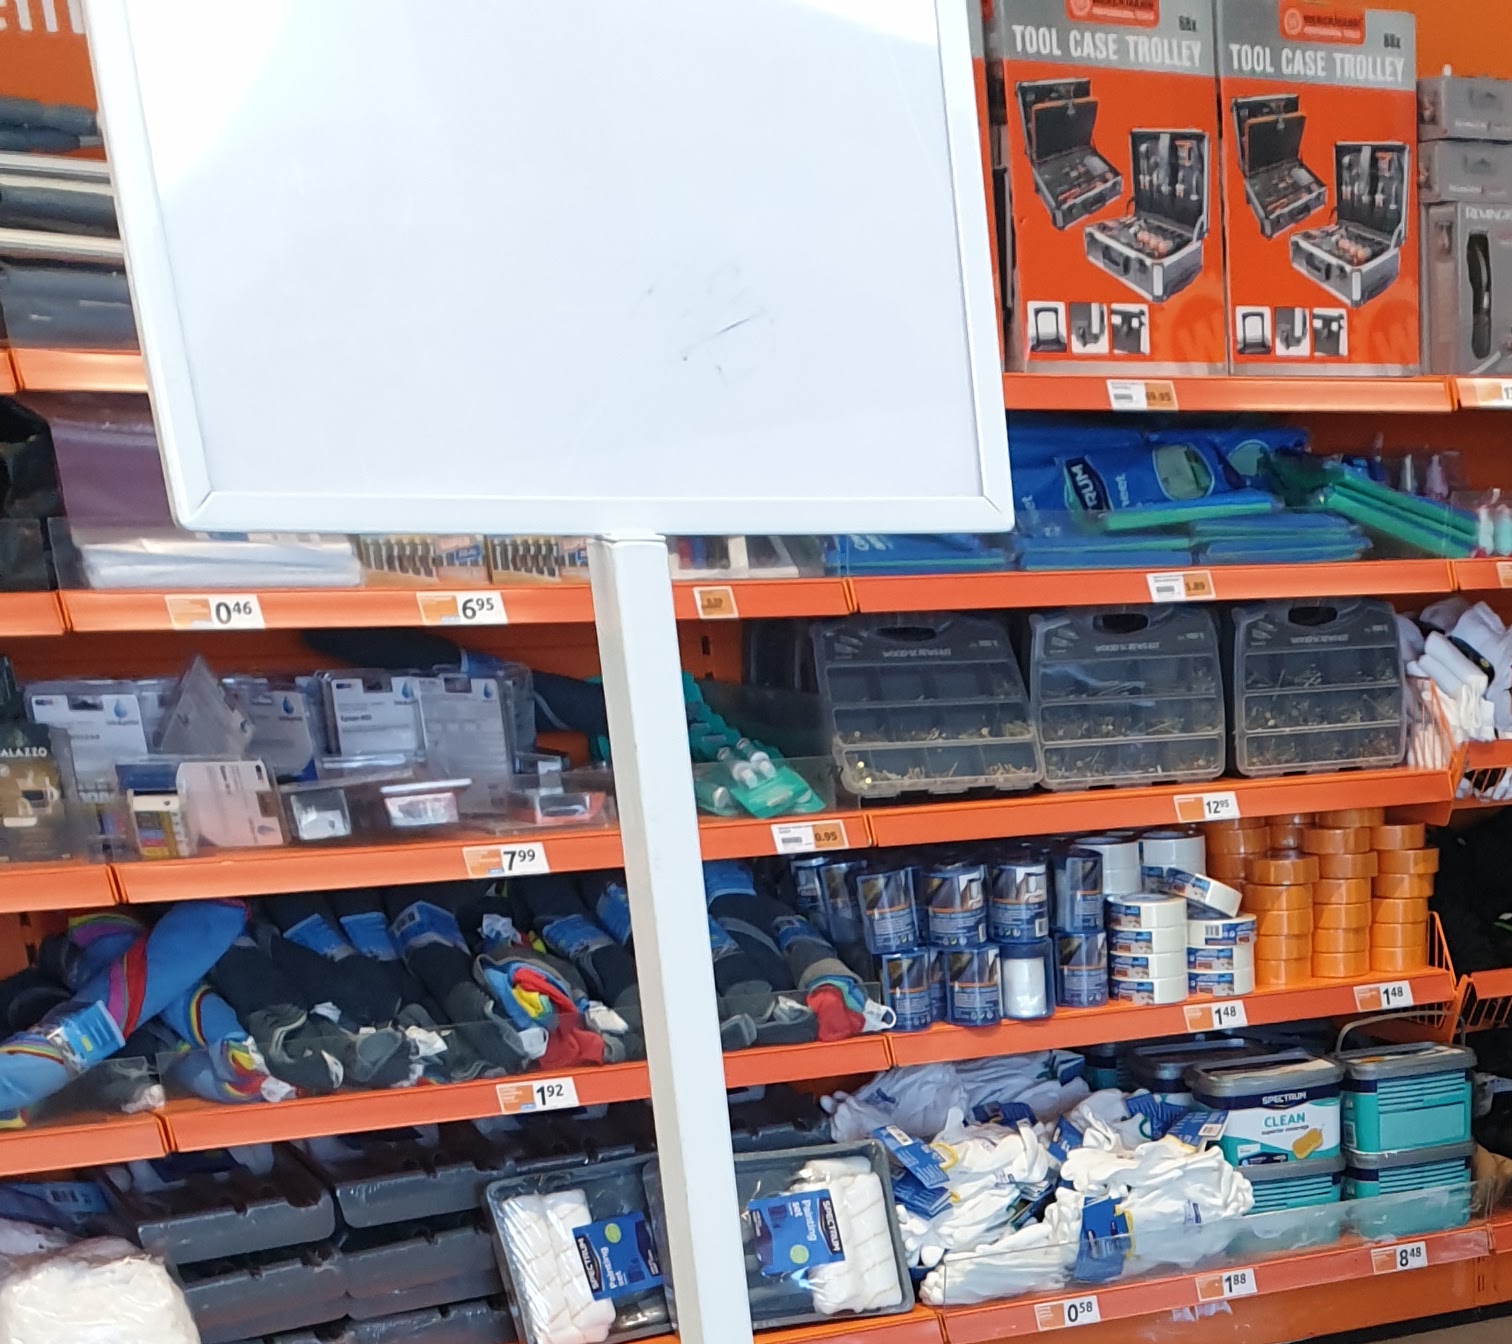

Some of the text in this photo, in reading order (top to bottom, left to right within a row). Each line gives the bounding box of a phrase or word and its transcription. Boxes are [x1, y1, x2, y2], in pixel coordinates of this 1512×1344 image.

[1012, 24, 1201, 69] TOOL CASE TROLLEY
[1229, 43, 1405, 83] TOOL CASE TROLLEY
[0, 746, 48, 758] ALAZZO
[1262, 1091, 1307, 1105] SPECTRUM
[1264, 1112, 1306, 1128] CLEAN
[801, 1199, 818, 1242] Painting
[822, 1200, 841, 1252] SPECTRUM
[577, 1236, 600, 1290] SPECTRUM
[600, 1246, 618, 1290] Painting
